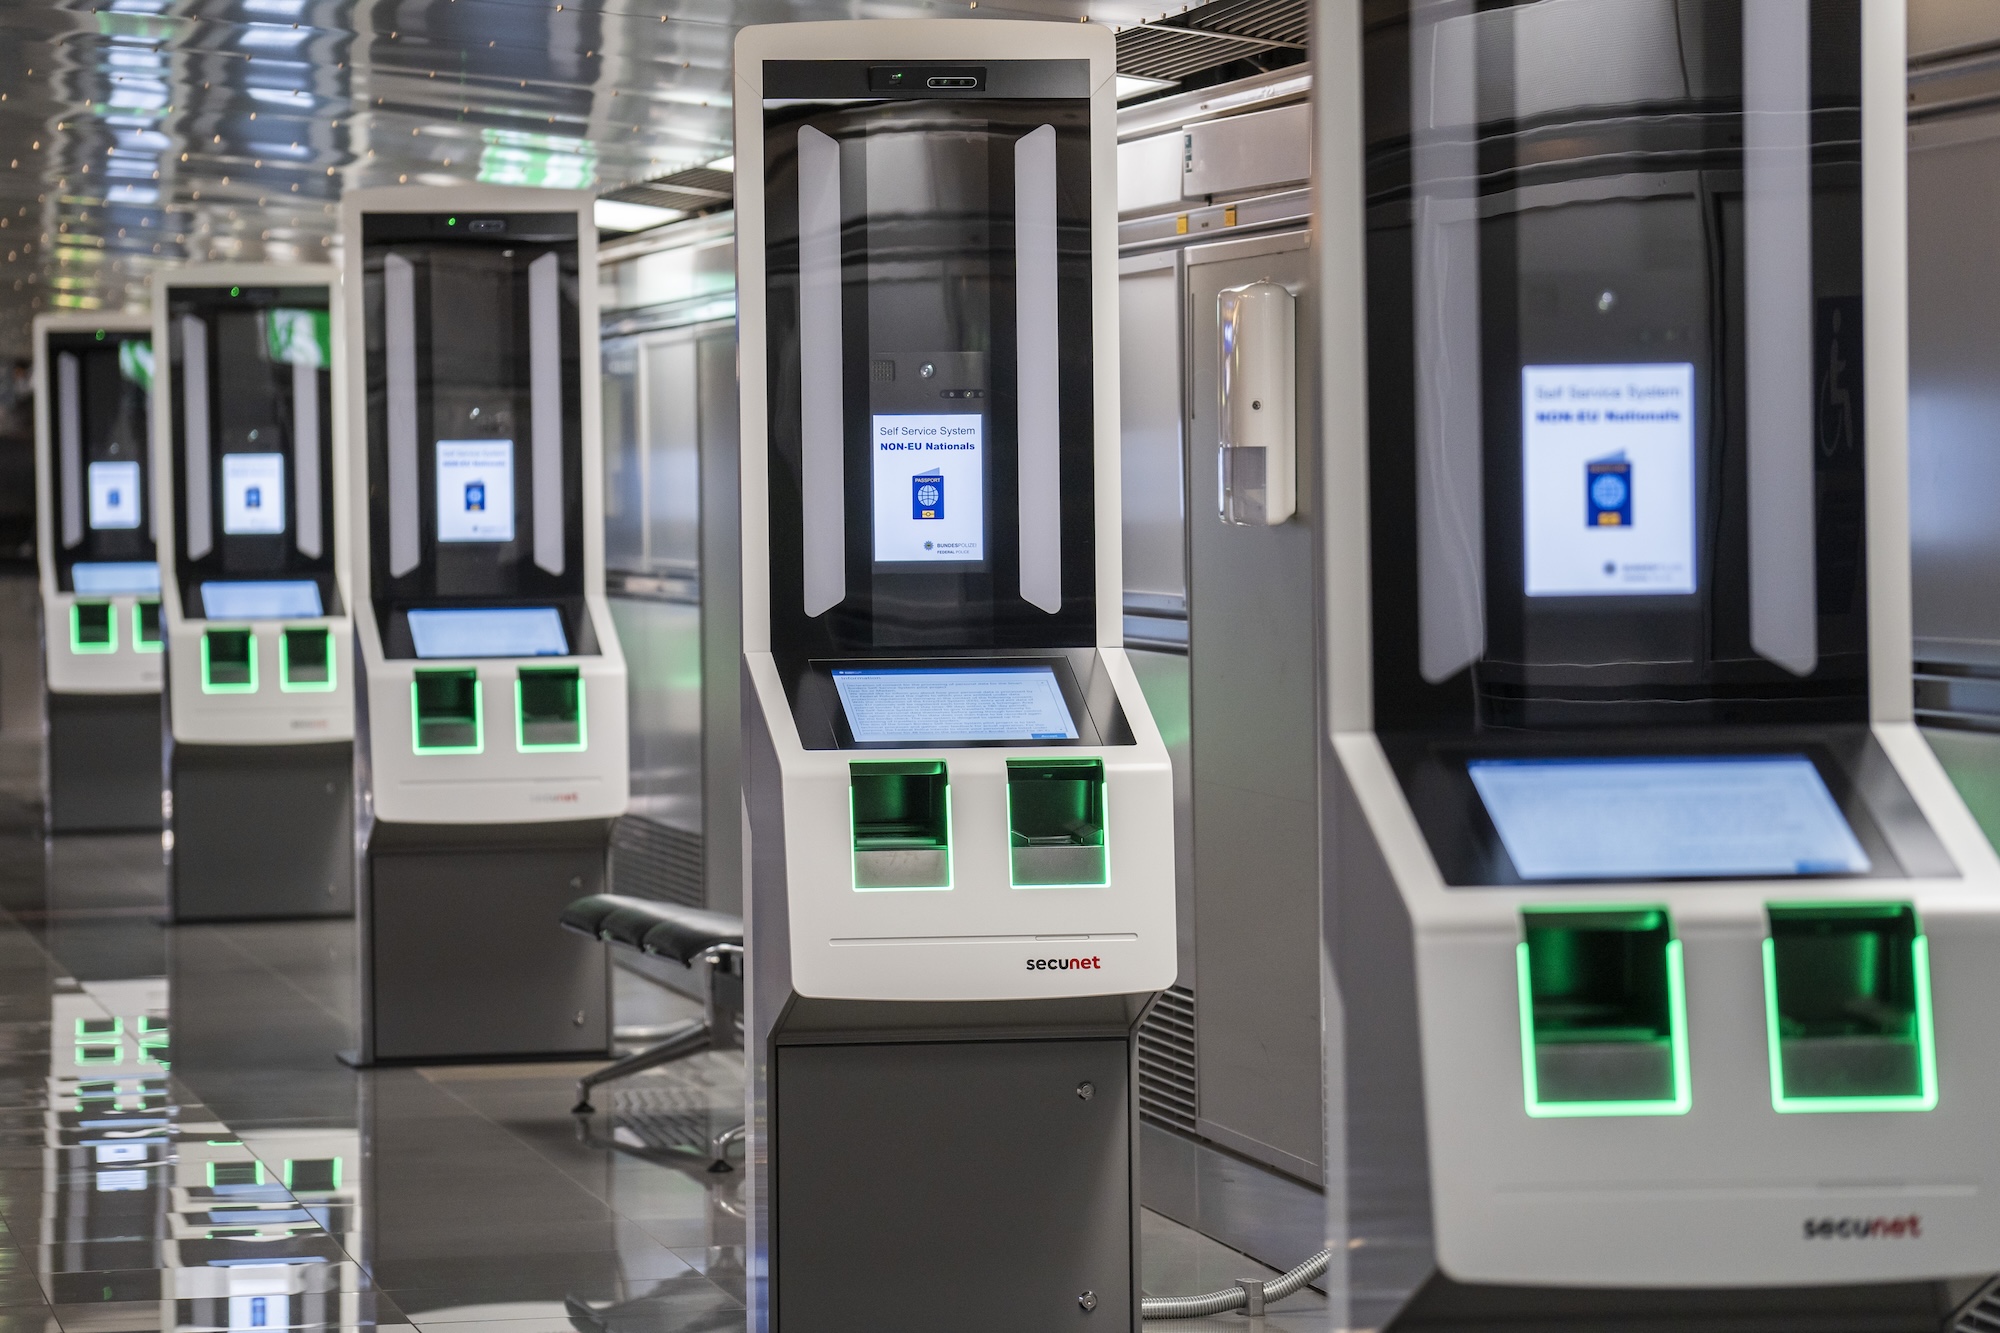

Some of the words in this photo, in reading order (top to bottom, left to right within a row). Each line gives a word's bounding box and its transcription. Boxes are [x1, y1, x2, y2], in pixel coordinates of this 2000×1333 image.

[1536, 386, 1564, 399] Self
[1571, 386, 1621, 399] Service
[1628, 385, 1680, 402] System
[1536, 411, 1598, 423] NON-EU
[1605, 410, 1680, 422] Nationals
[880, 426, 898, 436] Self
[901, 426, 937, 436] Service
[940, 426, 976, 437] System
[880, 442, 922, 451] NON-EU
[926, 442, 975, 450] Nationals
[1026, 955, 1101, 971] secunet
[1803, 1213, 1923, 1240] secunet
